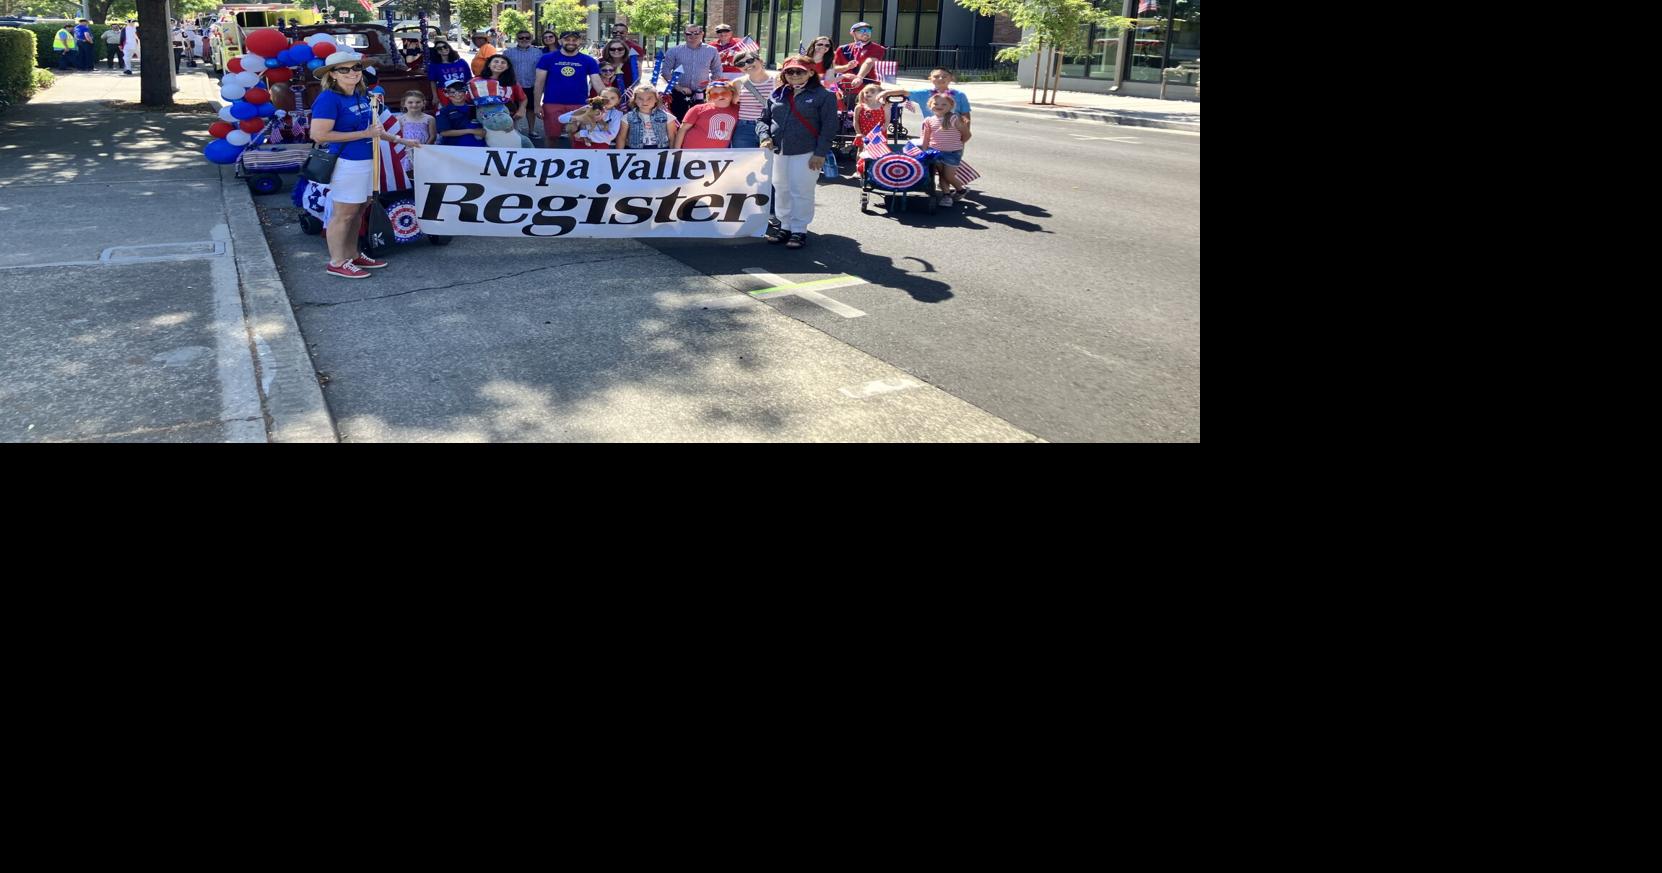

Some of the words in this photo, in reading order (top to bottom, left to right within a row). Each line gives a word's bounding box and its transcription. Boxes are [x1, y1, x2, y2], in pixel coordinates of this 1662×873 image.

[443, 72, 465, 81] USA
[480, 150, 590, 187] Napa
[606, 150, 734, 187] Valley
[417, 183, 770, 237] Register
